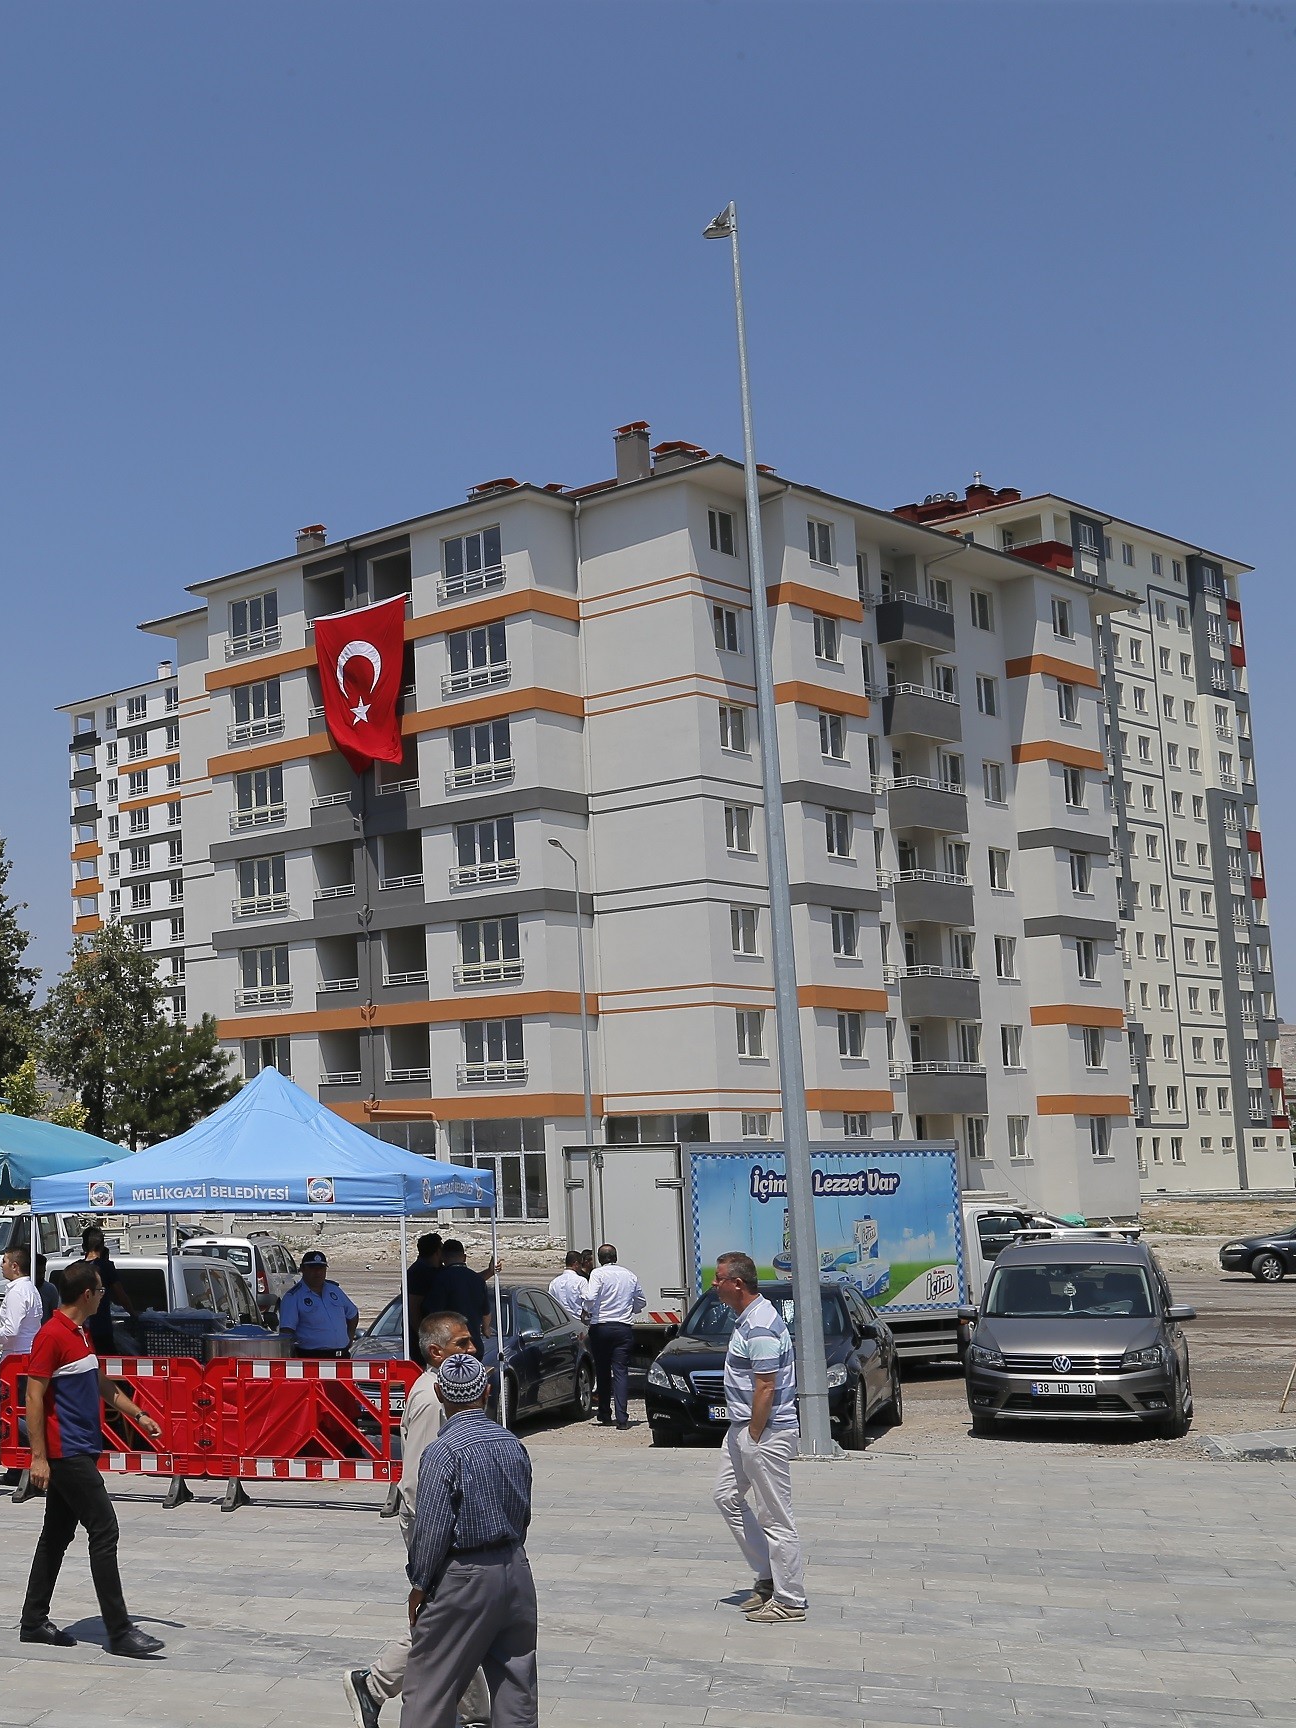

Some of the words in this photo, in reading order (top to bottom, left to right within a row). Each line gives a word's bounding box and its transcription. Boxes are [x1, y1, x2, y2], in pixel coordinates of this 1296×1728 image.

[815, 1173, 865, 1192] Lezzet
[132, 1183, 206, 1201] MELİKGAZİ
[210, 1184, 289, 1200] BELEDİYESİ
[925, 1272, 954, 1301] İçim
[1037, 1383, 1050, 1394] 38
[1057, 1383, 1070, 1394] HD
[1077, 1383, 1094, 1394] 130
[715, 1407, 726, 1418] 38
